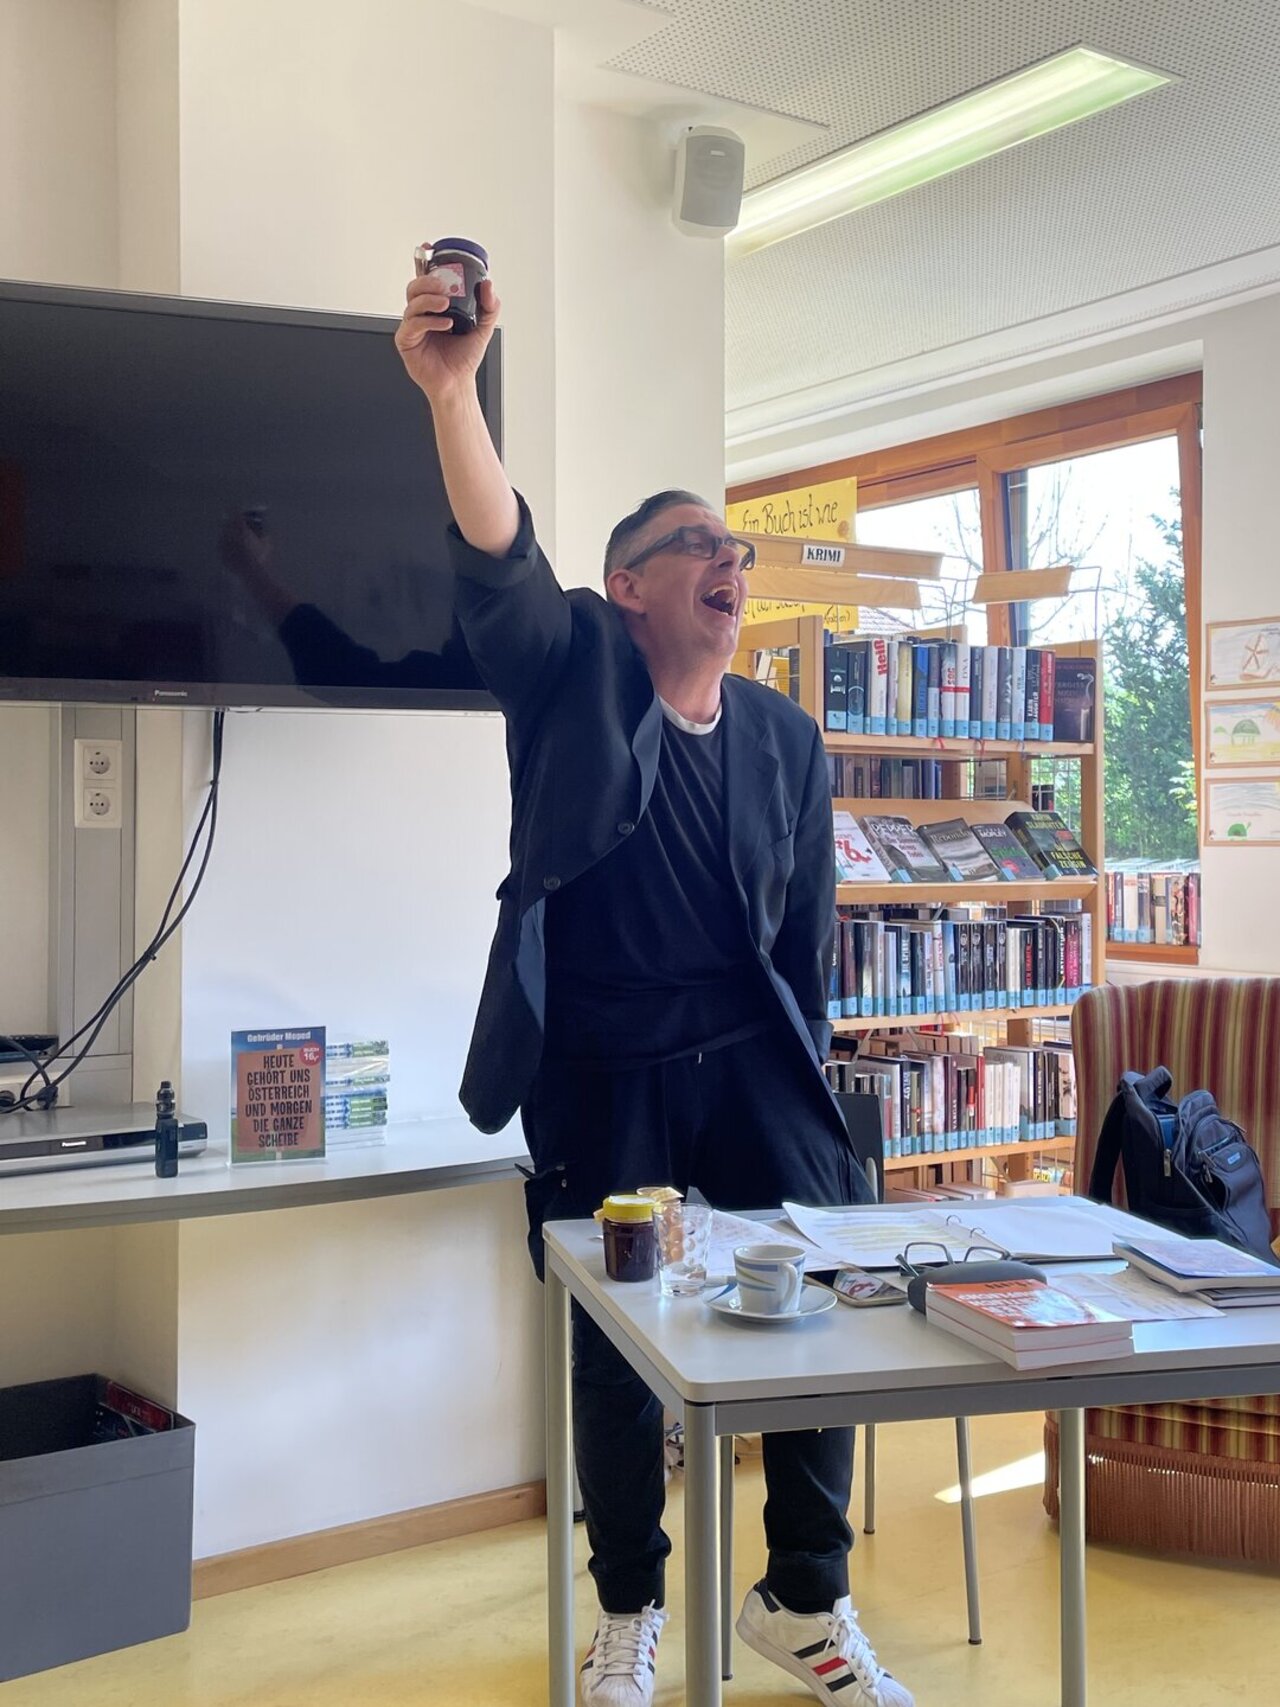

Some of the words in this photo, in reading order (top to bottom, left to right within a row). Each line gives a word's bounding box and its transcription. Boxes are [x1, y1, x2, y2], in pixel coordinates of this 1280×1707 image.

[762, 500, 796, 534] Buch
[799, 493, 813, 528] ist
[816, 501, 839, 524] wie
[807, 547, 841, 562] KRIMI
[263, 1054, 295, 1069] HEUTE
[247, 1067, 286, 1086] GEHÖRT
[290, 1068, 311, 1084] UNS
[248, 1085, 310, 1102] ÖSTERREICH
[245, 1102, 267, 1118] UND
[270, 1100, 312, 1116] MORGEN
[253, 1118, 269, 1132] DIE
[273, 1116, 305, 1131] GANZE
[258, 1132, 299, 1148] SCHEIBE
